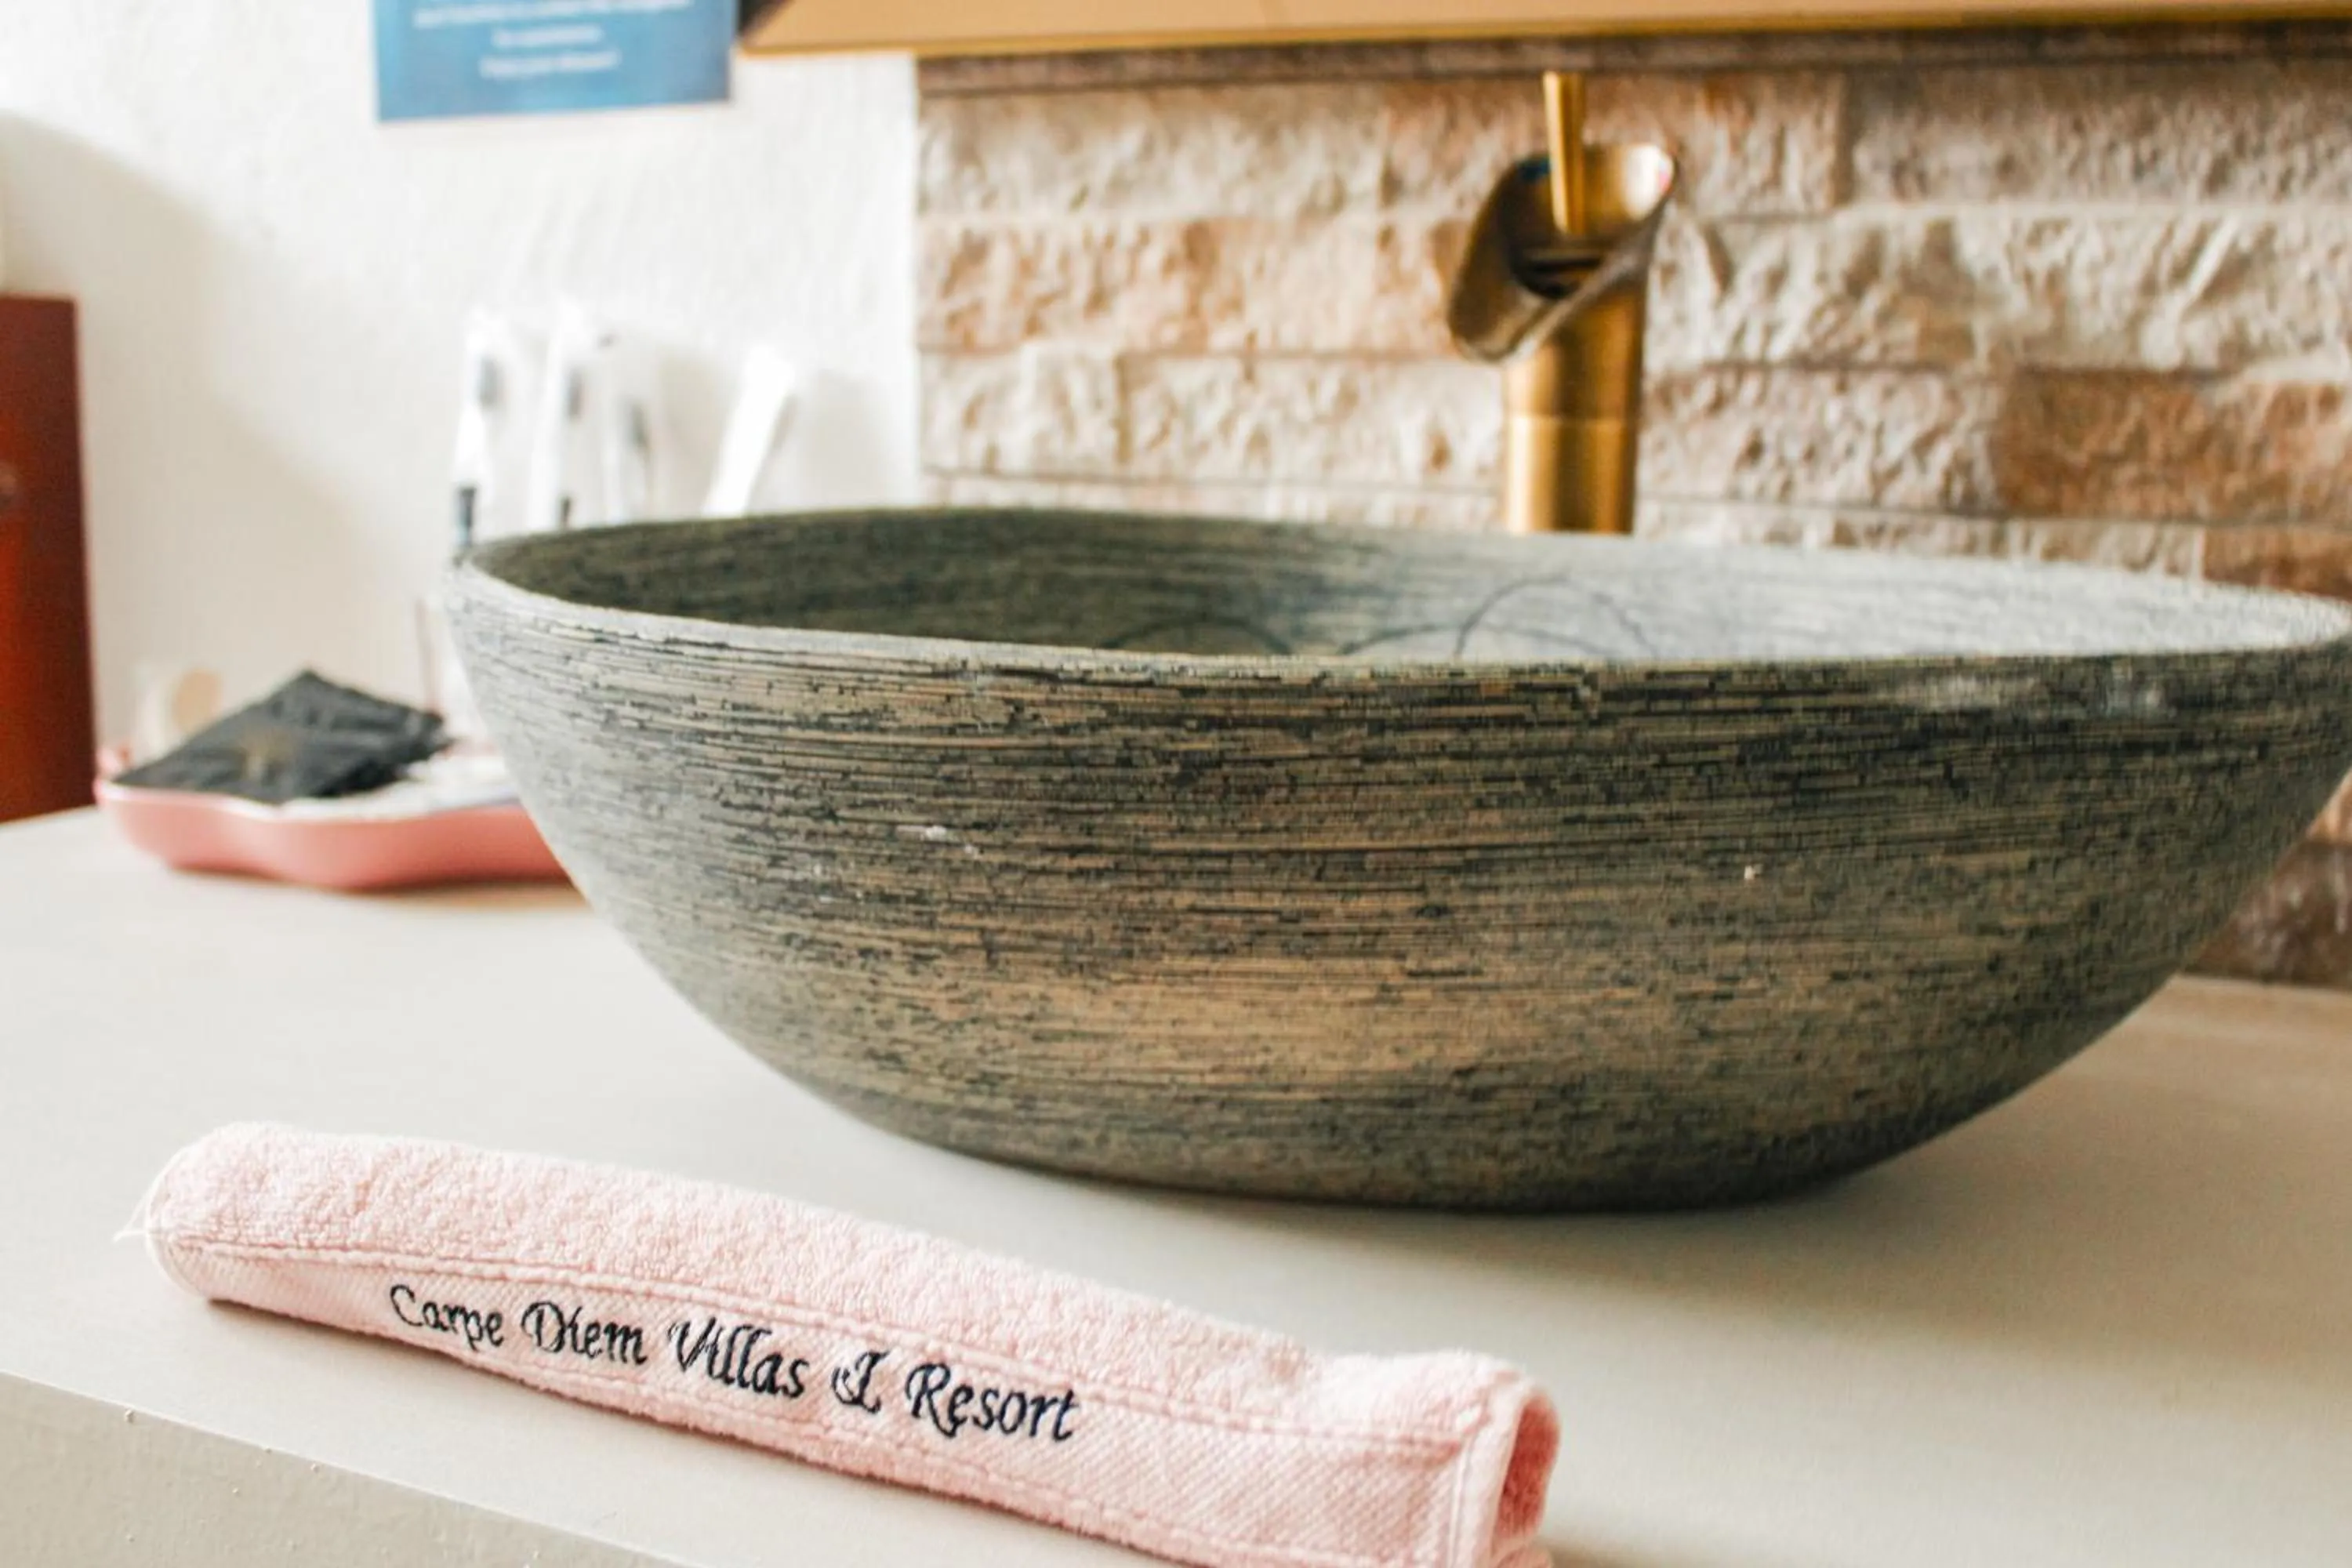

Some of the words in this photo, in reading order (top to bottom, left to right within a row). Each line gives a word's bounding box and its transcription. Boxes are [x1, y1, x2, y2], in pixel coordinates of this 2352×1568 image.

[390, 1284, 504, 1352] Carpe
[521, 1301, 648, 1365] Diem
[668, 1317, 810, 1399] Villas
[905, 1362, 1080, 1441] Resort
